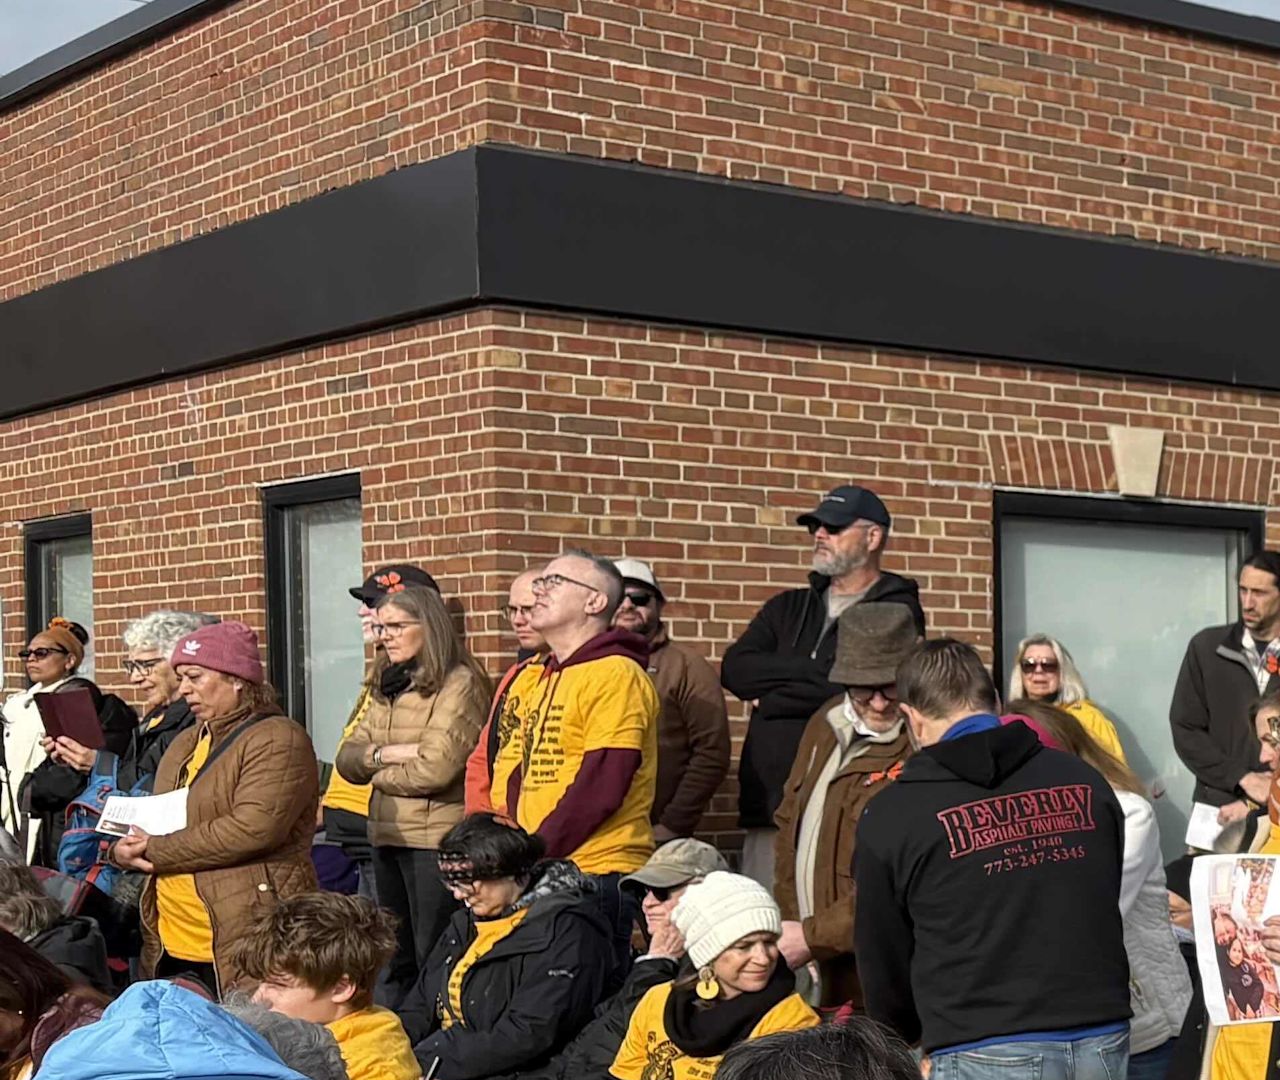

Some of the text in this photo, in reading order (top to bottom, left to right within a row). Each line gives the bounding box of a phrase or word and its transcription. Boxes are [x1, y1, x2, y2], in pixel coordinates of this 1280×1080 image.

[937, 784, 1096, 859] BEVERLY
[974, 820, 1028, 848] ASPHALT
[1003, 844, 1028, 856] est.
